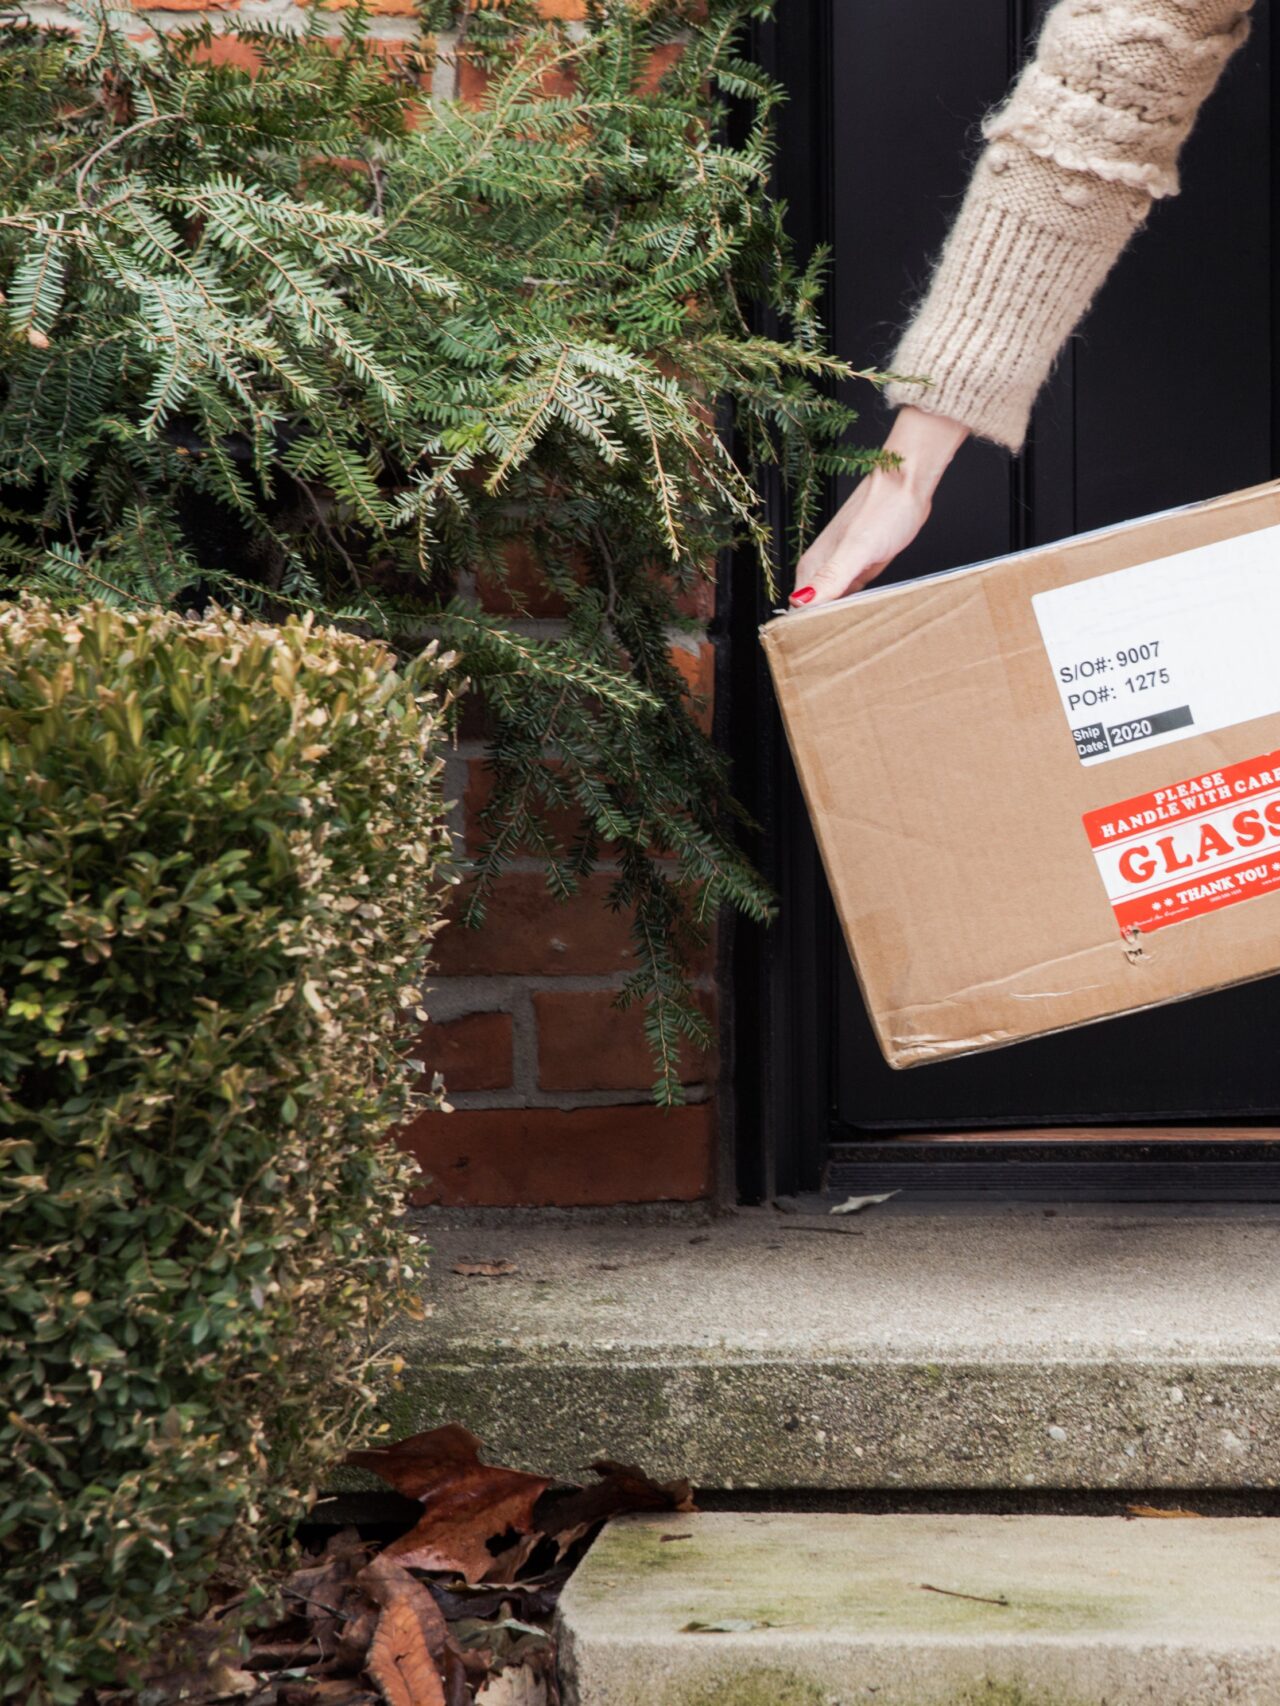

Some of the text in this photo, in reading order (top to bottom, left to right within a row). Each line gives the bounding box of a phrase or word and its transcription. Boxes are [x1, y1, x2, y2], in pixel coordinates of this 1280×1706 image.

[1059, 641, 1161, 684] S/O#: 9007
[1067, 668, 1170, 711] PO#: 1275
[1073, 725, 1100, 743] Ship
[1077, 738, 1108, 755] Date:
[1111, 720, 1152, 744] 2020
[1154, 772, 1225, 805] PLEASE
[1101, 802, 1180, 838] HANDLE
[1183, 785, 1232, 810] WITH
[1176, 877, 1235, 905] THANK
[1234, 864, 1269, 885] YOU
